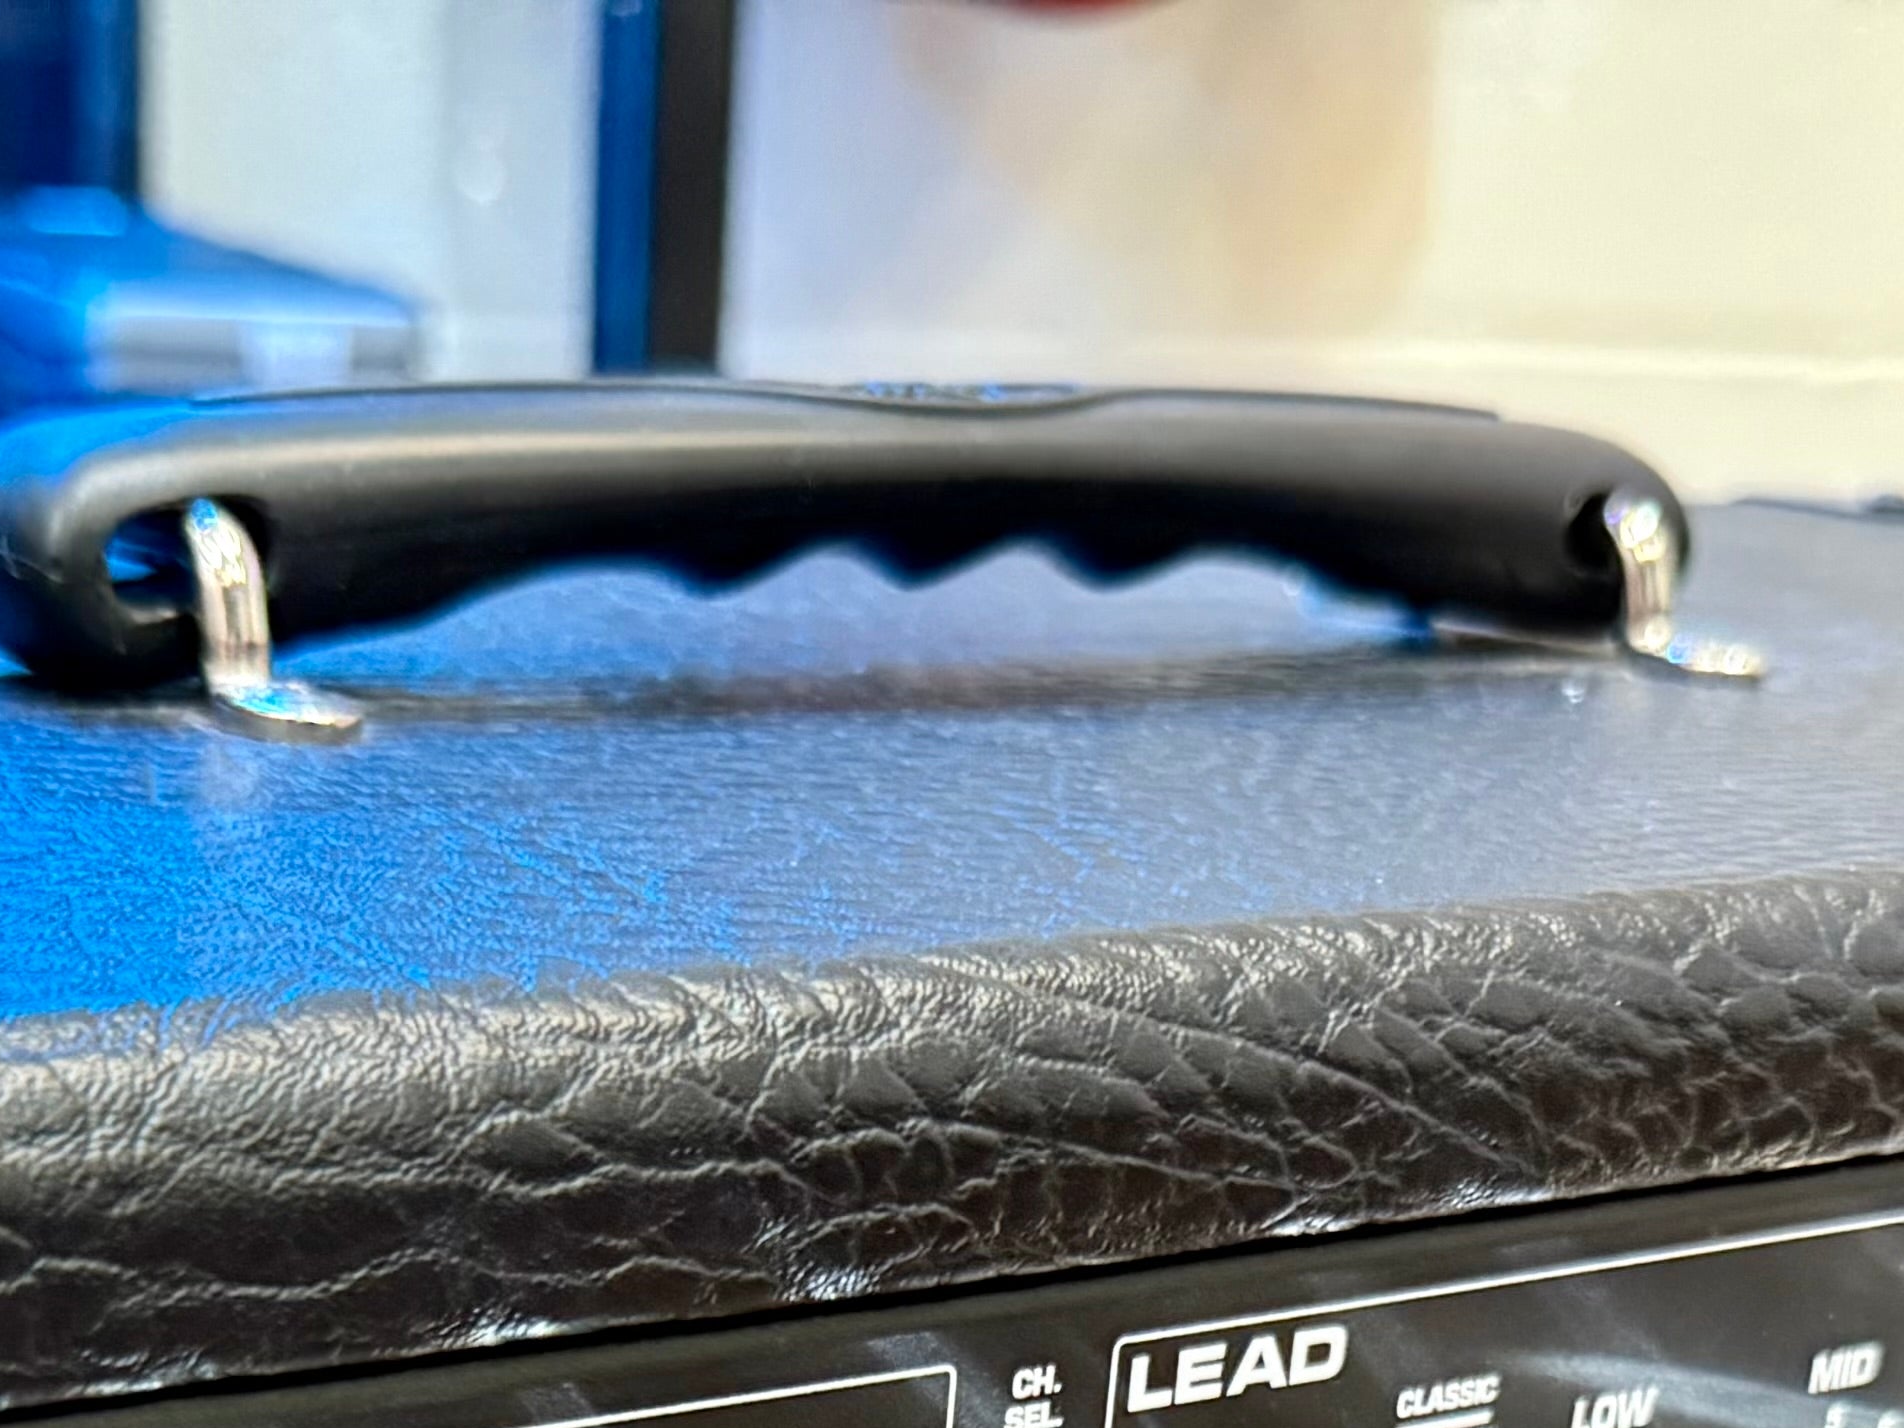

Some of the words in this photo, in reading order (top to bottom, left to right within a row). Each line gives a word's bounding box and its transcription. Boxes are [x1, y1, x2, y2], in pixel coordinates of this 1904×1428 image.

[1012, 1365, 1062, 1399] CH.
[1126, 1324, 1349, 1413] LEAD
[1808, 1343, 1881, 1394] MID
[1397, 1374, 1500, 1418] CLASSIC
